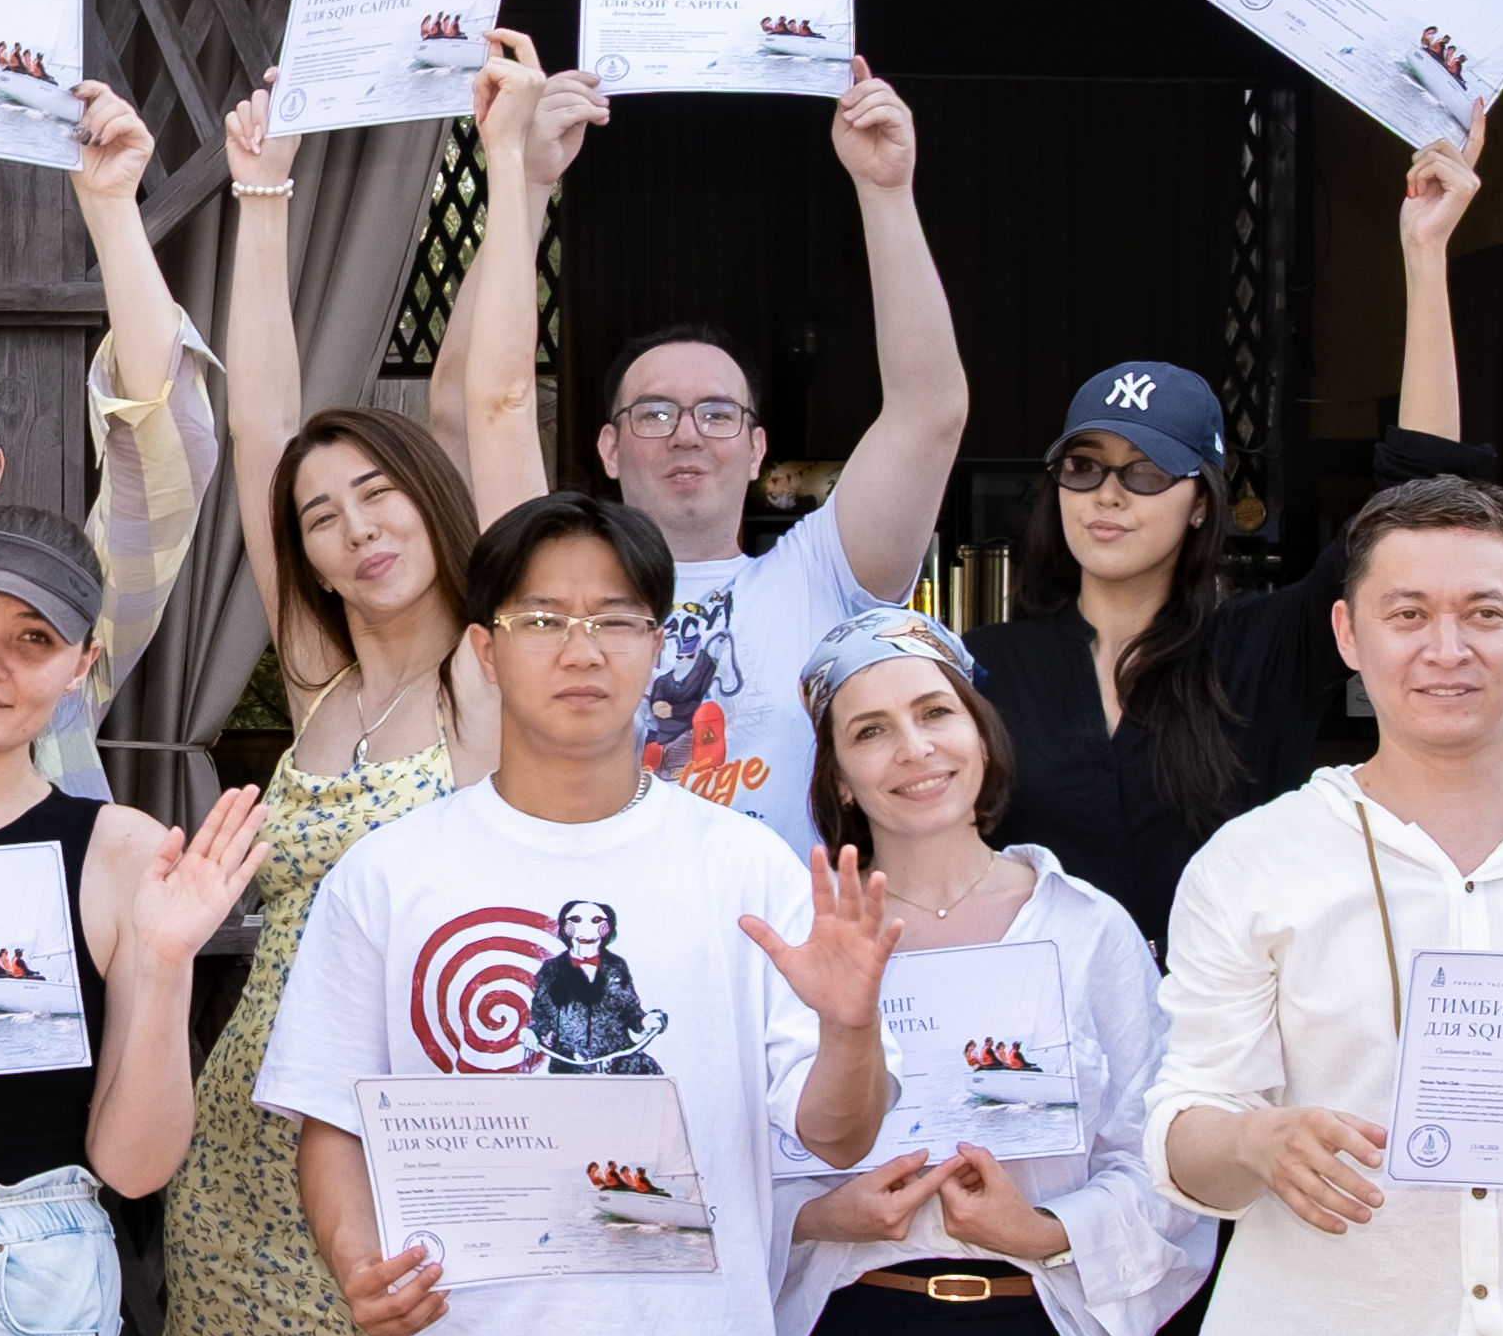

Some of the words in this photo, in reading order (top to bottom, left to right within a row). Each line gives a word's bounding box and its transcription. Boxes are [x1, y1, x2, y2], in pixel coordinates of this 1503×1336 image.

[888, 1017, 940, 1034] PITAL
[1424, 1022, 1460, 1038] ДЛЯ
[380, 1116, 530, 1132] ТИМБИЛДИНГ
[387, 1137, 420, 1152] ДЛЯ
[426, 1136, 469, 1153] SQIF
[476, 1136, 558, 1150] CAPITAL
